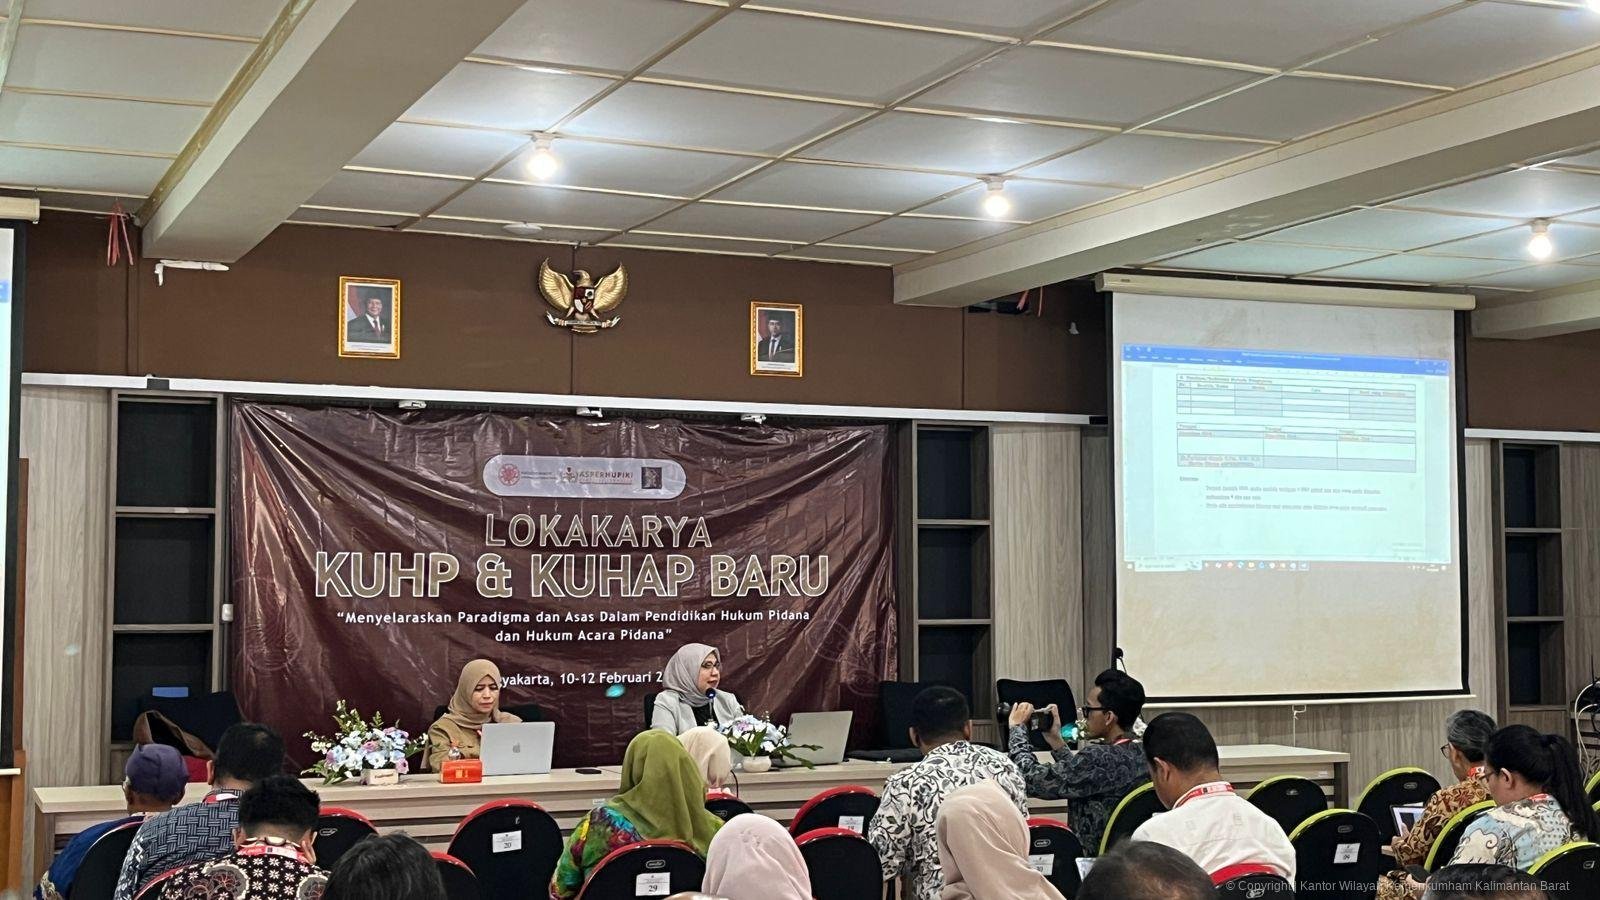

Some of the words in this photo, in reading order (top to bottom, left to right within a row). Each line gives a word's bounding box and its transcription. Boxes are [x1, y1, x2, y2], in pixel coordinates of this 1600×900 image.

[485, 513, 712, 547] LOKAKARYA
[315, 551, 460, 598] KUHP
[476, 553, 513, 598] &
[530, 553, 695, 598] KUHAP
[710, 554, 829, 597] BARU
[337, 612, 452, 625] “Menyelaraskan
[457, 612, 530, 625] Paradigma
[536, 611, 560, 623] dan
[565, 611, 595, 622] Asas
[600, 611, 640, 622] Dalam
[645, 610, 716, 622] Pendidikan
[721, 610, 764, 621] Hukum
[768, 610, 810, 621] Pidana
[495, 630, 520, 642] dan
[526, 630, 572, 642] Hukum
[577, 629, 615, 641] Acara
[620, 629, 672, 641] Pidana”
[500, 673, 554, 688] yakarta,
[560, 672, 596, 685] 10-12
[599, 671, 652, 684] Februari
[503, 841, 513, 850] 20
[648, 884, 659, 893] 29
